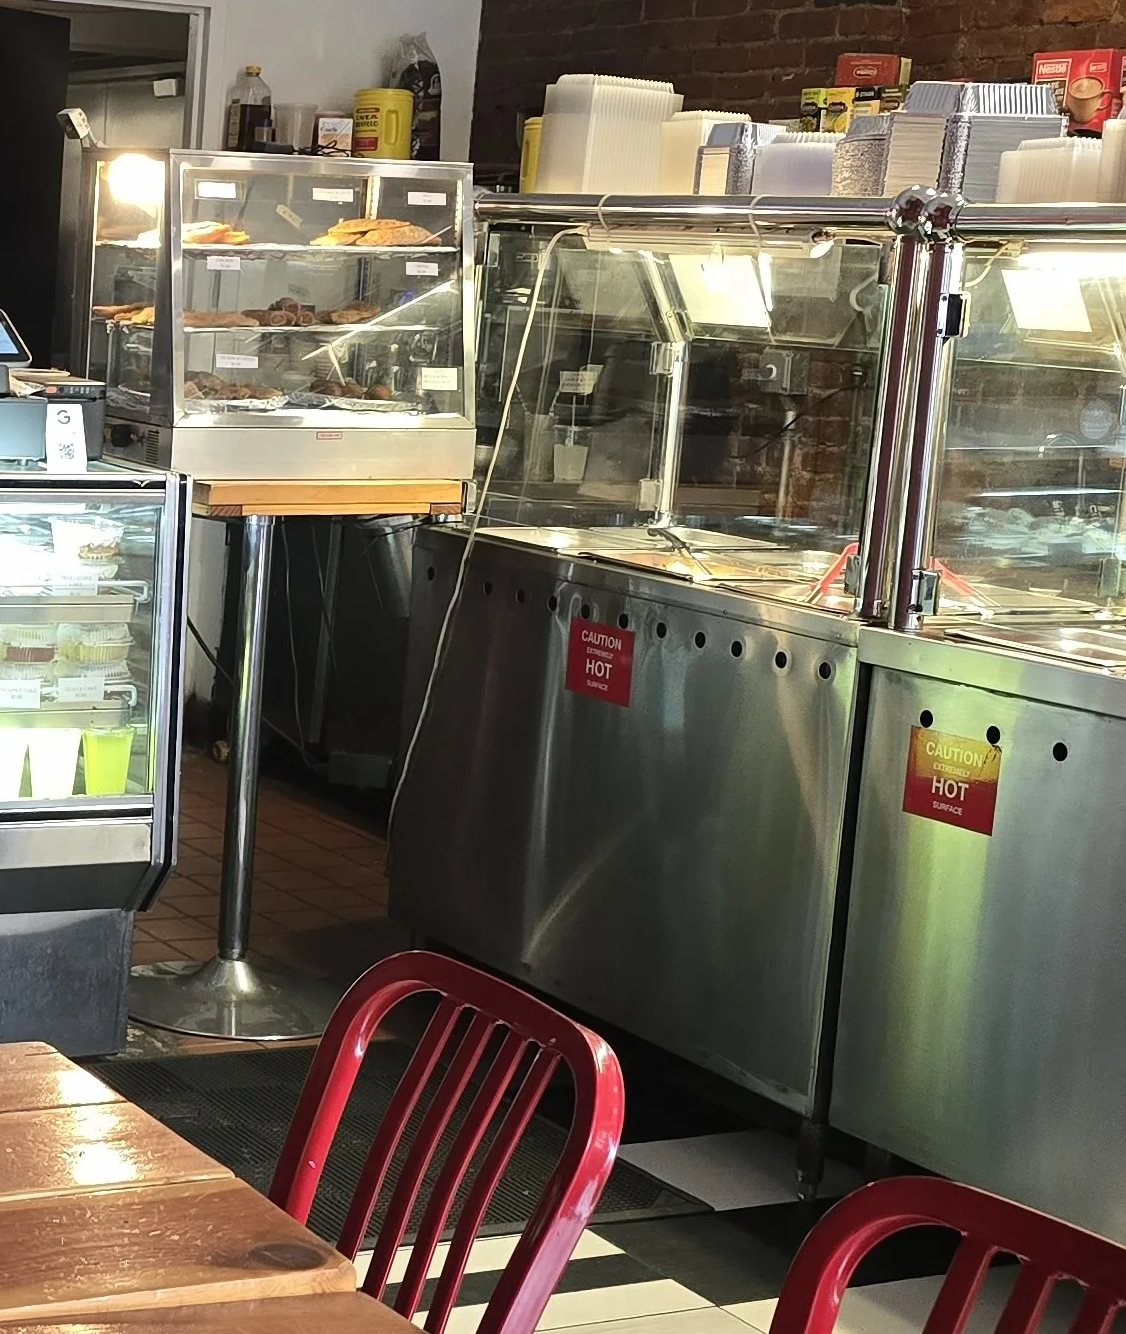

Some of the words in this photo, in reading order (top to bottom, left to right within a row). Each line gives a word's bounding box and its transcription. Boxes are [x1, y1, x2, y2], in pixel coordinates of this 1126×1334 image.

[581, 629, 622, 651] CAUTION
[586, 646, 614, 660] EXTREMELY
[585, 658, 613, 680] HOT
[586, 679, 609, 692] SURFACE
[925, 741, 983, 768] CAUTION
[932, 762, 971, 778] EXTREMELY
[931, 775, 970, 801] HOT
[932, 800, 963, 816] SURFACE
